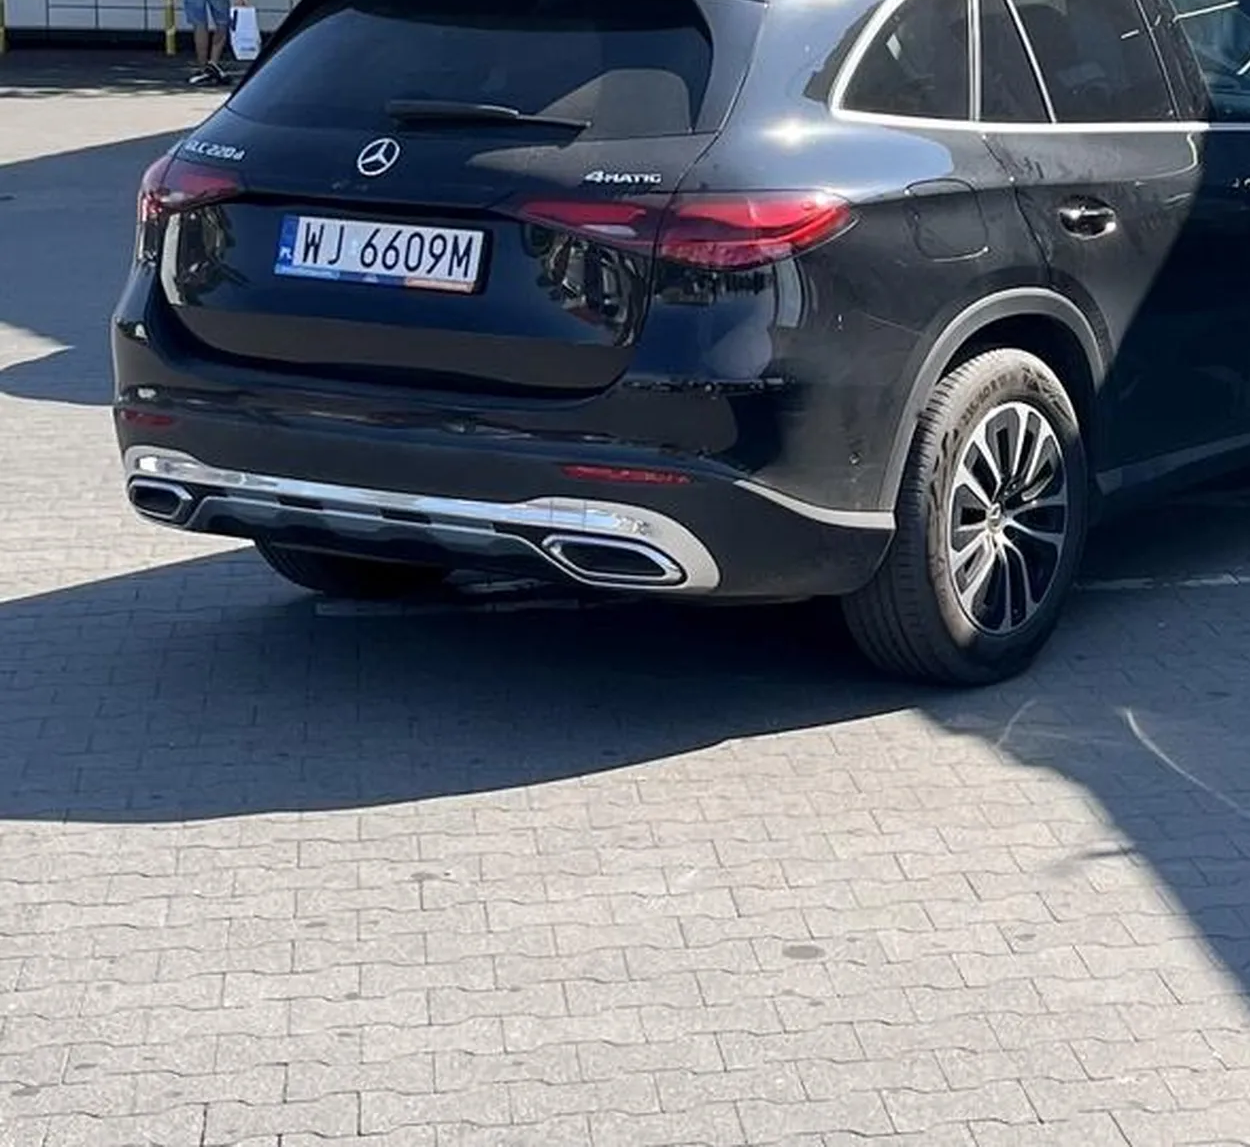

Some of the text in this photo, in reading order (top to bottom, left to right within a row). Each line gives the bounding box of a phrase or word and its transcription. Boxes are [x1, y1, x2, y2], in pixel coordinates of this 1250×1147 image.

[584, 170, 662, 184] 4MATIC
[302, 221, 474, 279] WJ 6609M
